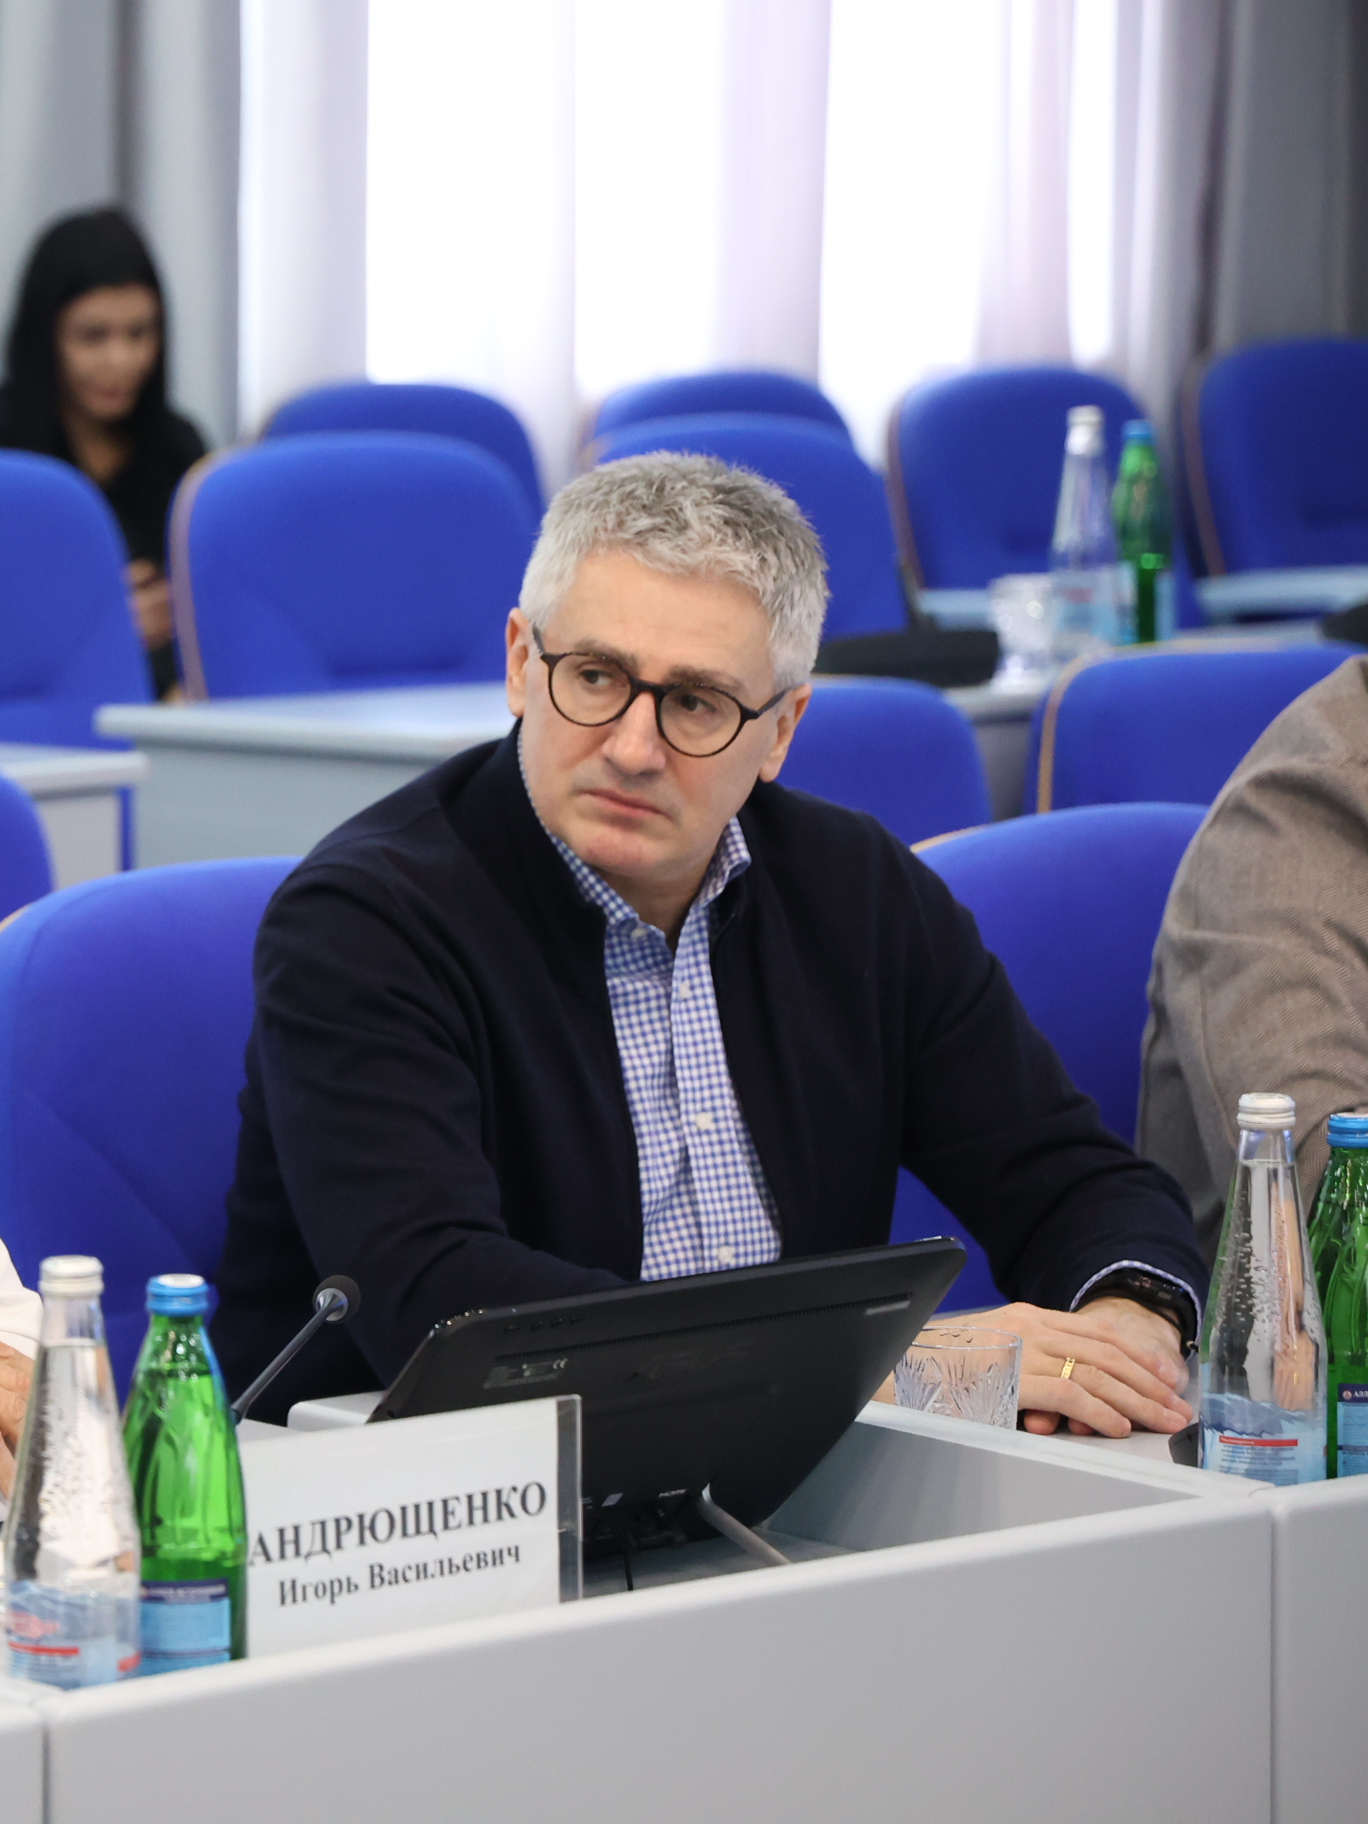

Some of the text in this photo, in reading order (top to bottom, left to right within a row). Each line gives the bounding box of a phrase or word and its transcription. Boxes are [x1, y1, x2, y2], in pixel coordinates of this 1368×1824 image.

[248, 1481, 547, 1567] АНДРЮЩЕНКО
[279, 1544, 521, 1606] Игорь Васильевич
